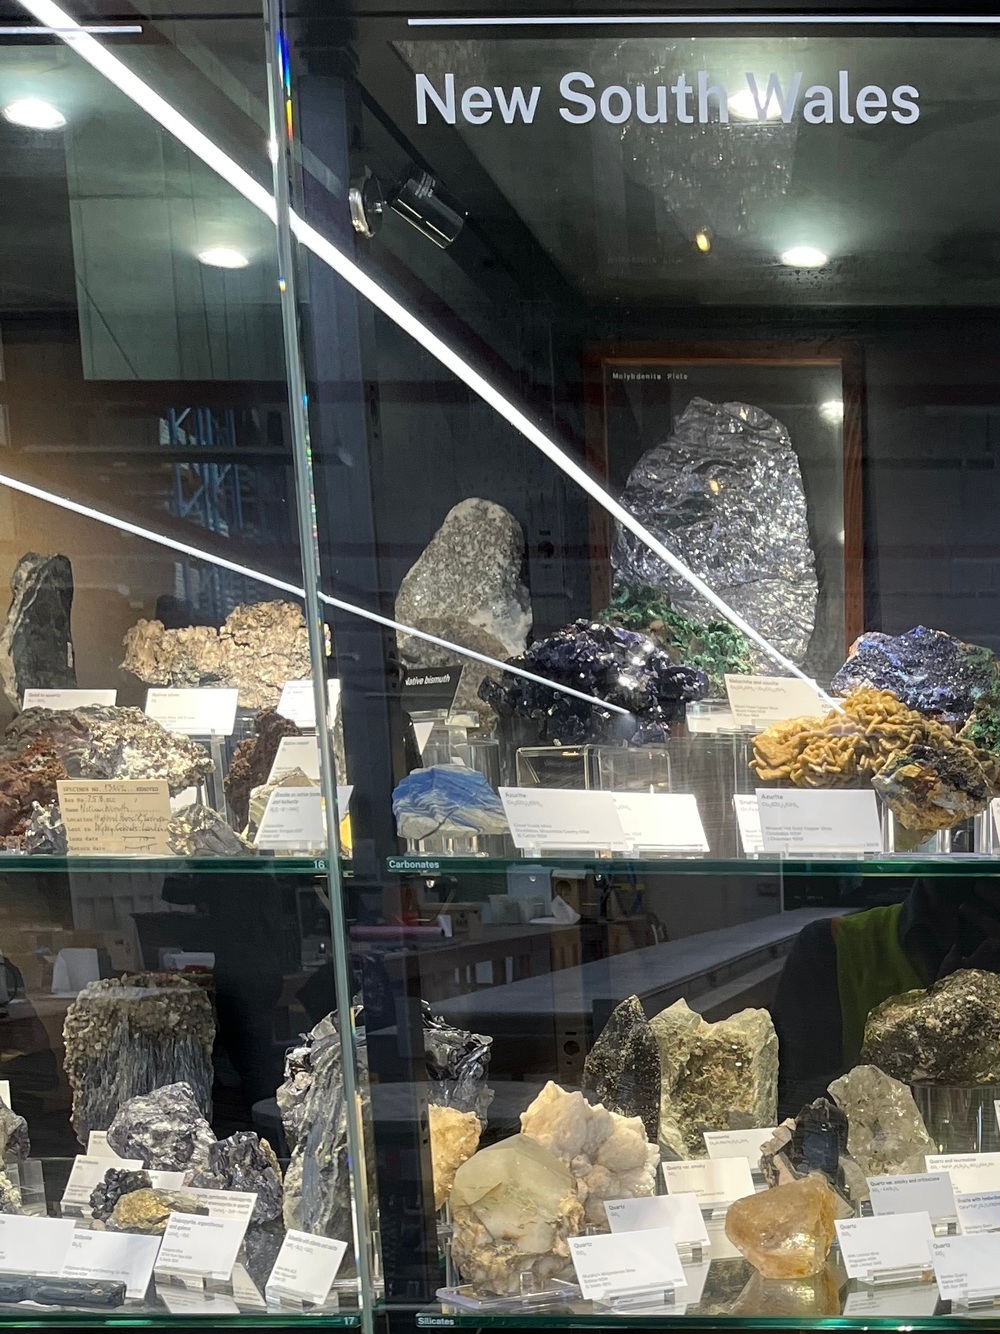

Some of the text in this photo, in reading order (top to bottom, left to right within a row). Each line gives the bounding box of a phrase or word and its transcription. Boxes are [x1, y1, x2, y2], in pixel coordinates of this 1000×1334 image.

[415, 70, 920, 126] New South Wales
[612, 372, 662, 382] Molybdenite
[424, 674, 451, 685] bismuth
[313, 860, 325, 870] 16
[388, 859, 440, 869] Carbonates
[573, 1241, 592, 1249] Quartz
[343, 1316, 355, 1325] 17
[418, 1317, 455, 1326] Silicates
